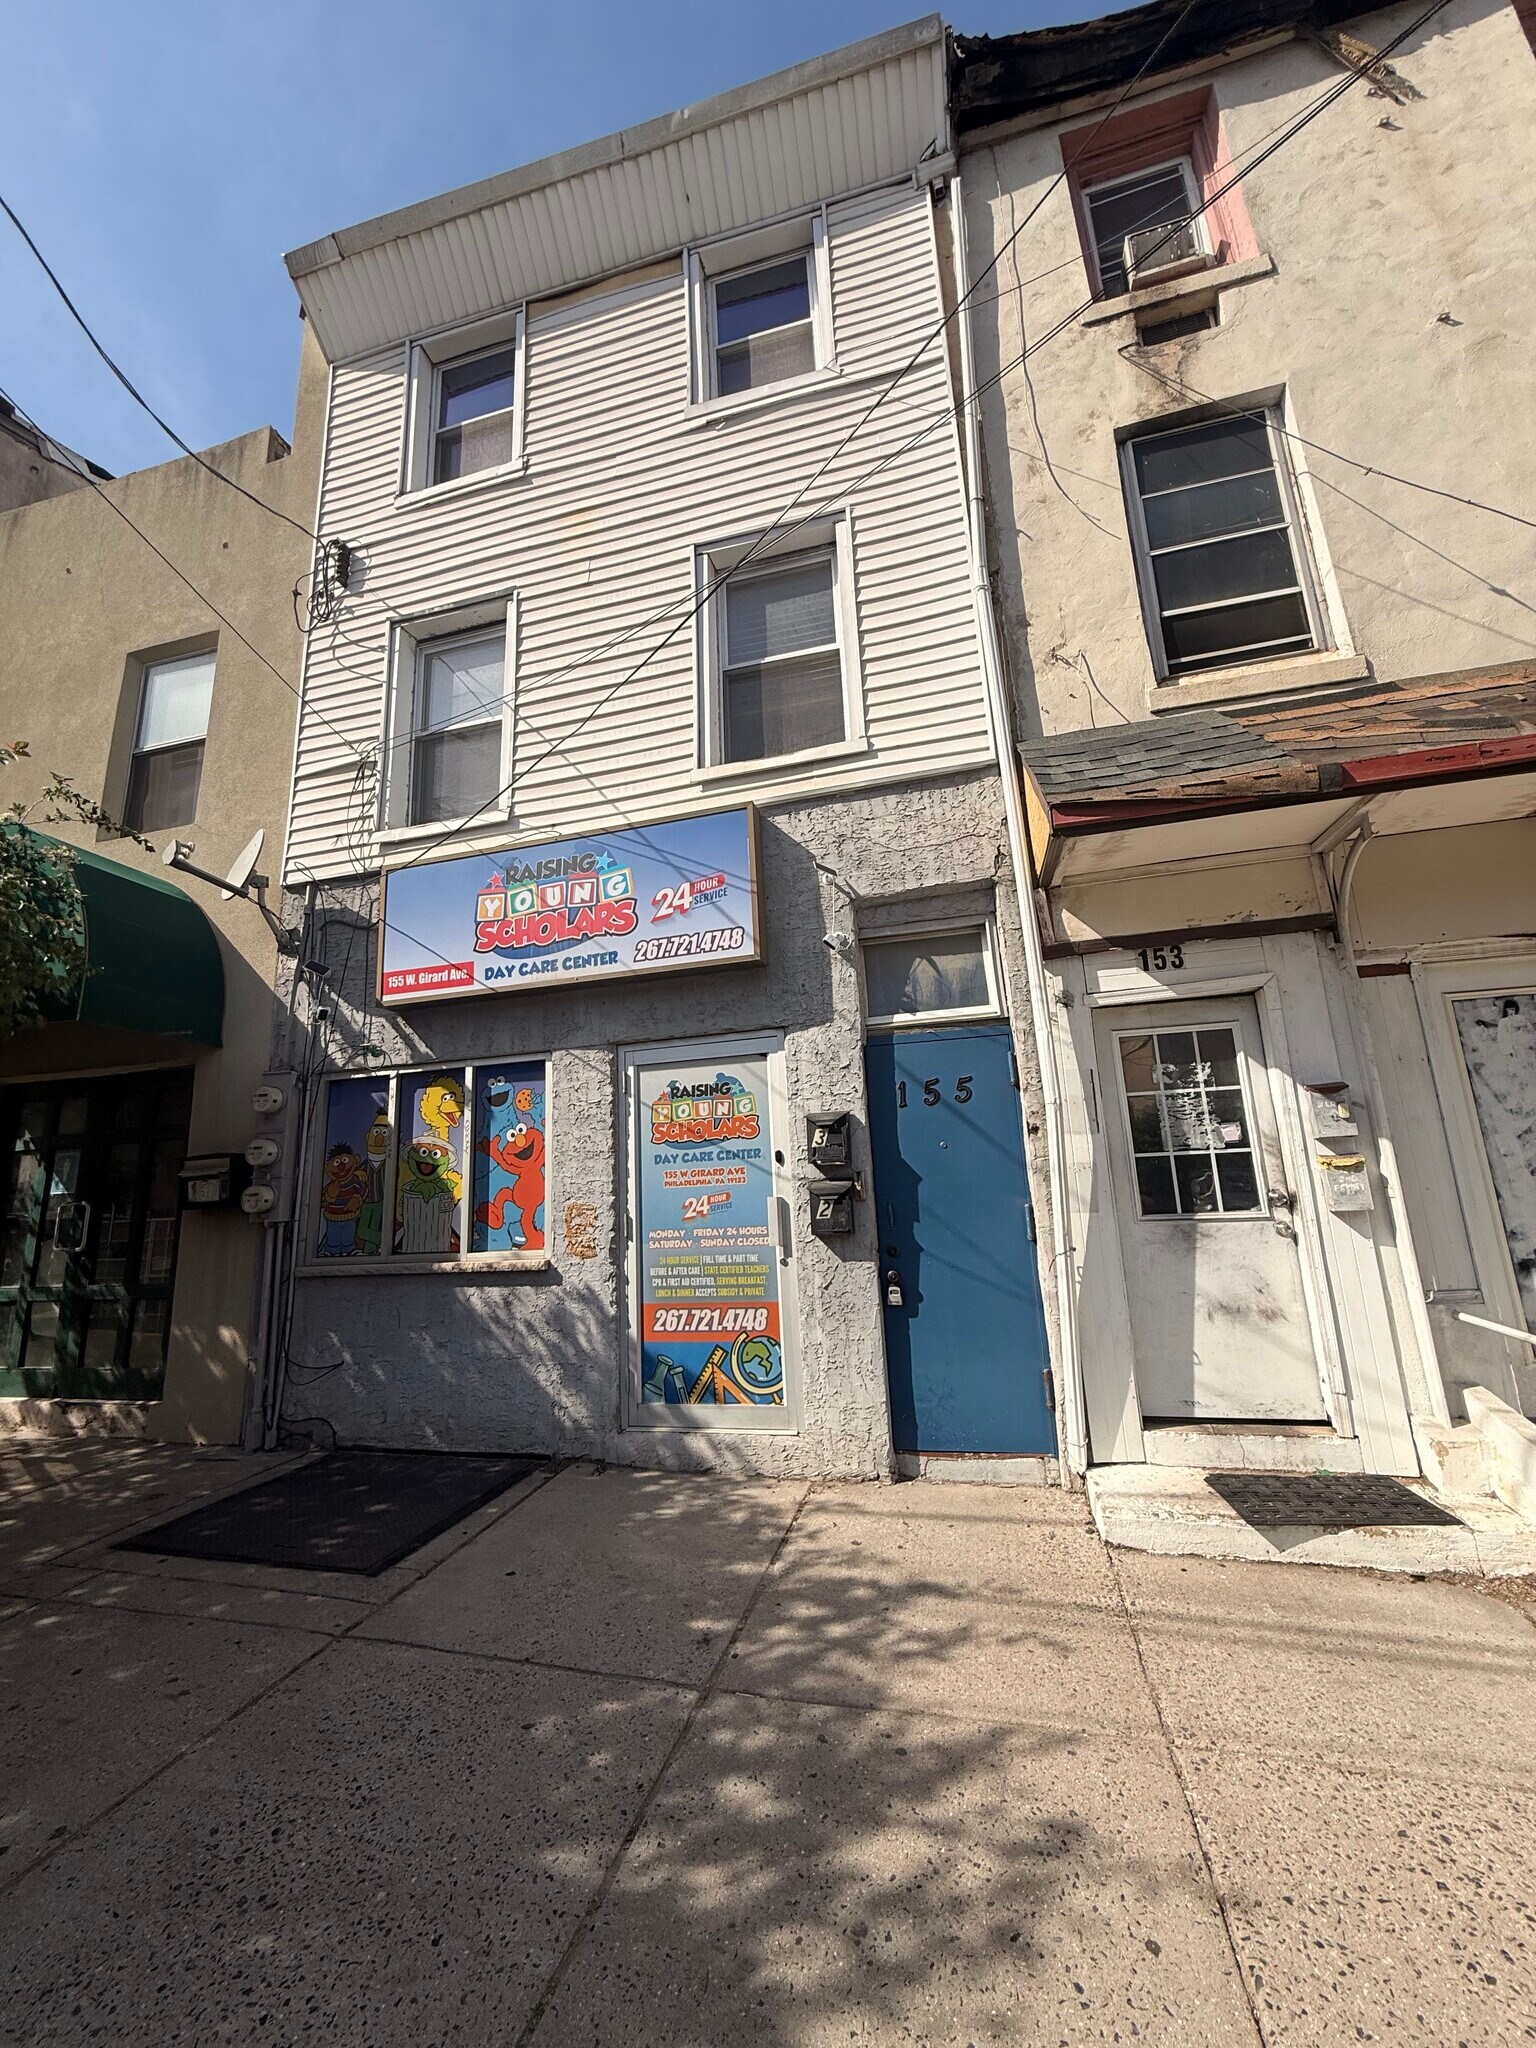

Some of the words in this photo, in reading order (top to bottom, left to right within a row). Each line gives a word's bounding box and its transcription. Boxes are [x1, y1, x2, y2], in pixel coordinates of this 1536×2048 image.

[505, 853, 597, 886] RAISING
[482, 873, 628, 919] YOUNG
[652, 882, 692, 922] 24
[694, 877, 719, 893] HOUR
[694, 887, 728, 905] SERVICE
[476, 898, 638, 952] SCHOLARS
[634, 926, 745, 962] 267.721.4748
[484, 964, 517, 981] DAY
[518, 958, 559, 977] CARE
[562, 950, 619, 971] CENTER
[1138, 945, 1184, 972] 153
[387, 975, 404, 988] 155
[406, 974, 418, 986] W.
[418, 969, 449, 985] Girard
[449, 968, 470, 981] Ave.
[669, 1082, 732, 1100] RAISING
[898, 1076, 974, 1108] 155
[655, 1097, 754, 1121] YOUNG
[652, 1115, 760, 1144] SCHOLARS
[814, 1130, 826, 1146] 3
[654, 1152, 680, 1165] DAY
[681, 1151, 714, 1164] CARE
[716, 1148, 762, 1161] CENTER
[664, 1170, 678, 1179] 155
[680, 1170, 689, 1178] W
[690, 1168, 725, 1178] GIRARD
[727, 1166, 746, 1176] AVE
[664, 1179, 712, 1188] PHILADELPHIA
[727, 1176, 746, 1184] 19123
[682, 1194, 709, 1220] 24
[710, 1193, 727, 1204] HOUR
[710, 1202, 733, 1212] SERVICE
[818, 1200, 831, 1218] 2
[648, 1229, 686, 1239] MONDAY
[693, 1228, 725, 1237] FRIDAY
[726, 1227, 737, 1236] 24
[740, 1226, 768, 1236] HOURS
[648, 1240, 693, 1249] SATURDAY
[700, 1239, 735, 1248] SUNDAY
[737, 1237, 770, 1247] CLOSED
[680, 1256, 700, 1264] SERVICE
[703, 1255, 714, 1264] FULL
[715, 1254, 727, 1263] TIME
[733, 1254, 745, 1263] PART
[746, 1253, 759, 1262] TIME
[650, 1267, 667, 1276] BEFORE
[673, 1267, 687, 1276] AFTER
[688, 1266, 701, 1275] CARE
[704, 1265, 719, 1275] STATE
[719, 1265, 744, 1274] CERTIFIED
[744, 1264, 770, 1274] TEACHERS
[652, 1278, 662, 1287] CPR
[667, 1278, 680, 1287] FIRST
[681, 1277, 690, 1286] AID
[716, 1276, 737, 1285] SERVING
[655, 1289, 671, 1298] LUNCH
[677, 1288, 695, 1297] DINNER
[695, 1288, 717, 1297] ACCEPTS
[717, 1287, 738, 1297] SUBSIDY
[744, 1287, 765, 1296] PRIVATE
[653, 1307, 769, 1333] 267.721.4748
